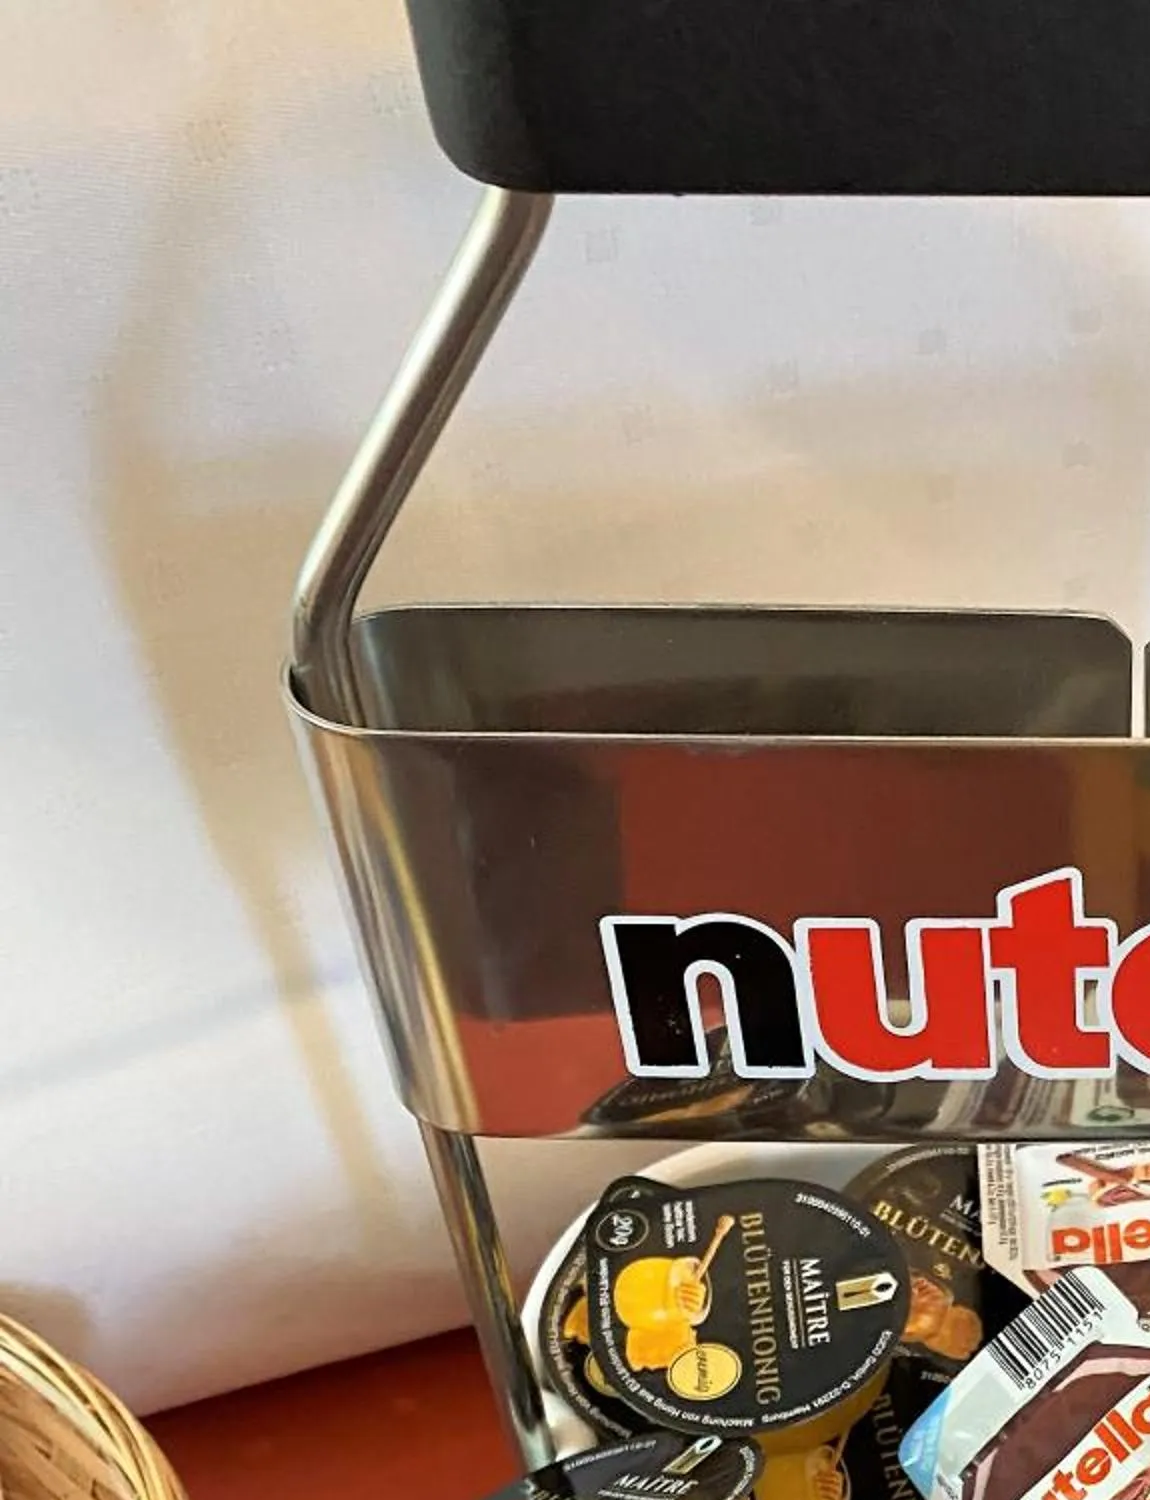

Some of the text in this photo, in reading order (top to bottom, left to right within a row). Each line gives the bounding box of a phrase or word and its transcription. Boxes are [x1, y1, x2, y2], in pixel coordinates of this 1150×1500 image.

[872, 1199, 982, 1266] BLÜTEN
[740, 1212, 782, 1406] BLÜTENHONIG
[1021, 1309, 1105, 1390] 8075 1151
